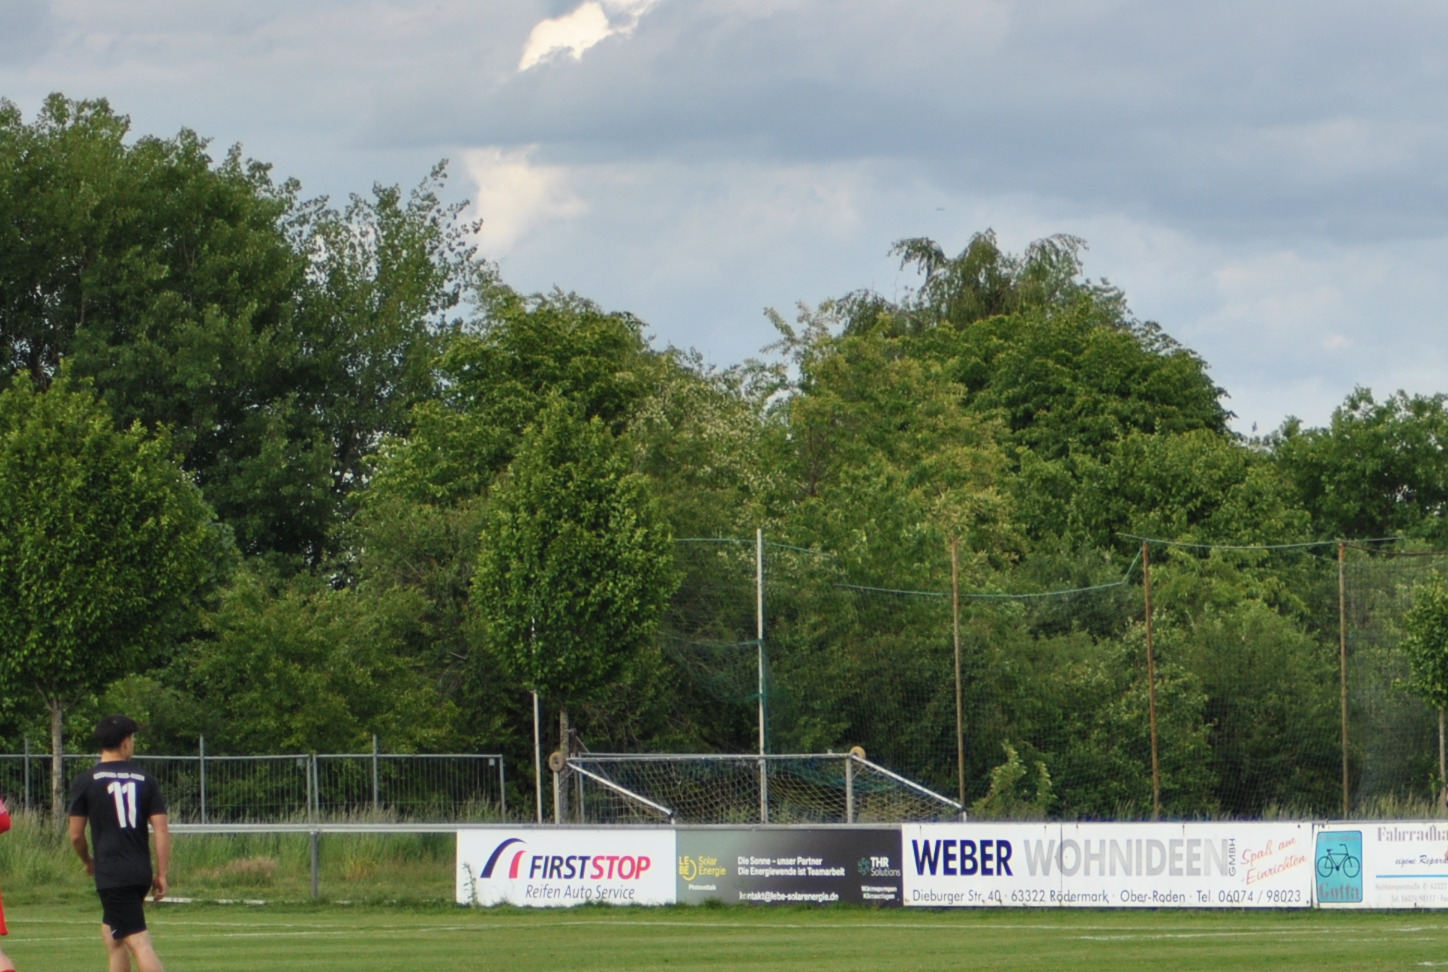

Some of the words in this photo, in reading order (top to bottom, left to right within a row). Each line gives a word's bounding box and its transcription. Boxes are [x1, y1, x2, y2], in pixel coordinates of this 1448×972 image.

[107, 781, 136, 829] 11
[699, 856, 717, 865] Solar
[738, 856, 750, 866] Die
[797, 856, 823, 866] Partner
[870, 856, 890, 868] THR
[912, 839, 1014, 877] WEBER
[1023, 839, 1228, 877] WOHNIDEEN
[1228, 838, 1236, 877] GMBH
[529, 855, 651, 880] FIRSTSTOP
[699, 866, 727, 877] Energie
[738, 867, 750, 876] Die
[870, 868, 901, 877] Solutions
[525, 884, 561, 899] Reifen
[564, 885, 591, 899] Auto
[595, 885, 635, 899] Service
[912, 889, 965, 904] Dieburger
[987, 889, 1001, 902] 40
[1011, 889, 1046, 902] 63322
[1050, 889, 1109, 902] Rödermark
[1119, 890, 1186, 903] Ober-Roden
[1196, 890, 1214, 903] Tel.
[1218, 890, 1254, 902] 06074
[1266, 890, 1301, 902] 98023
